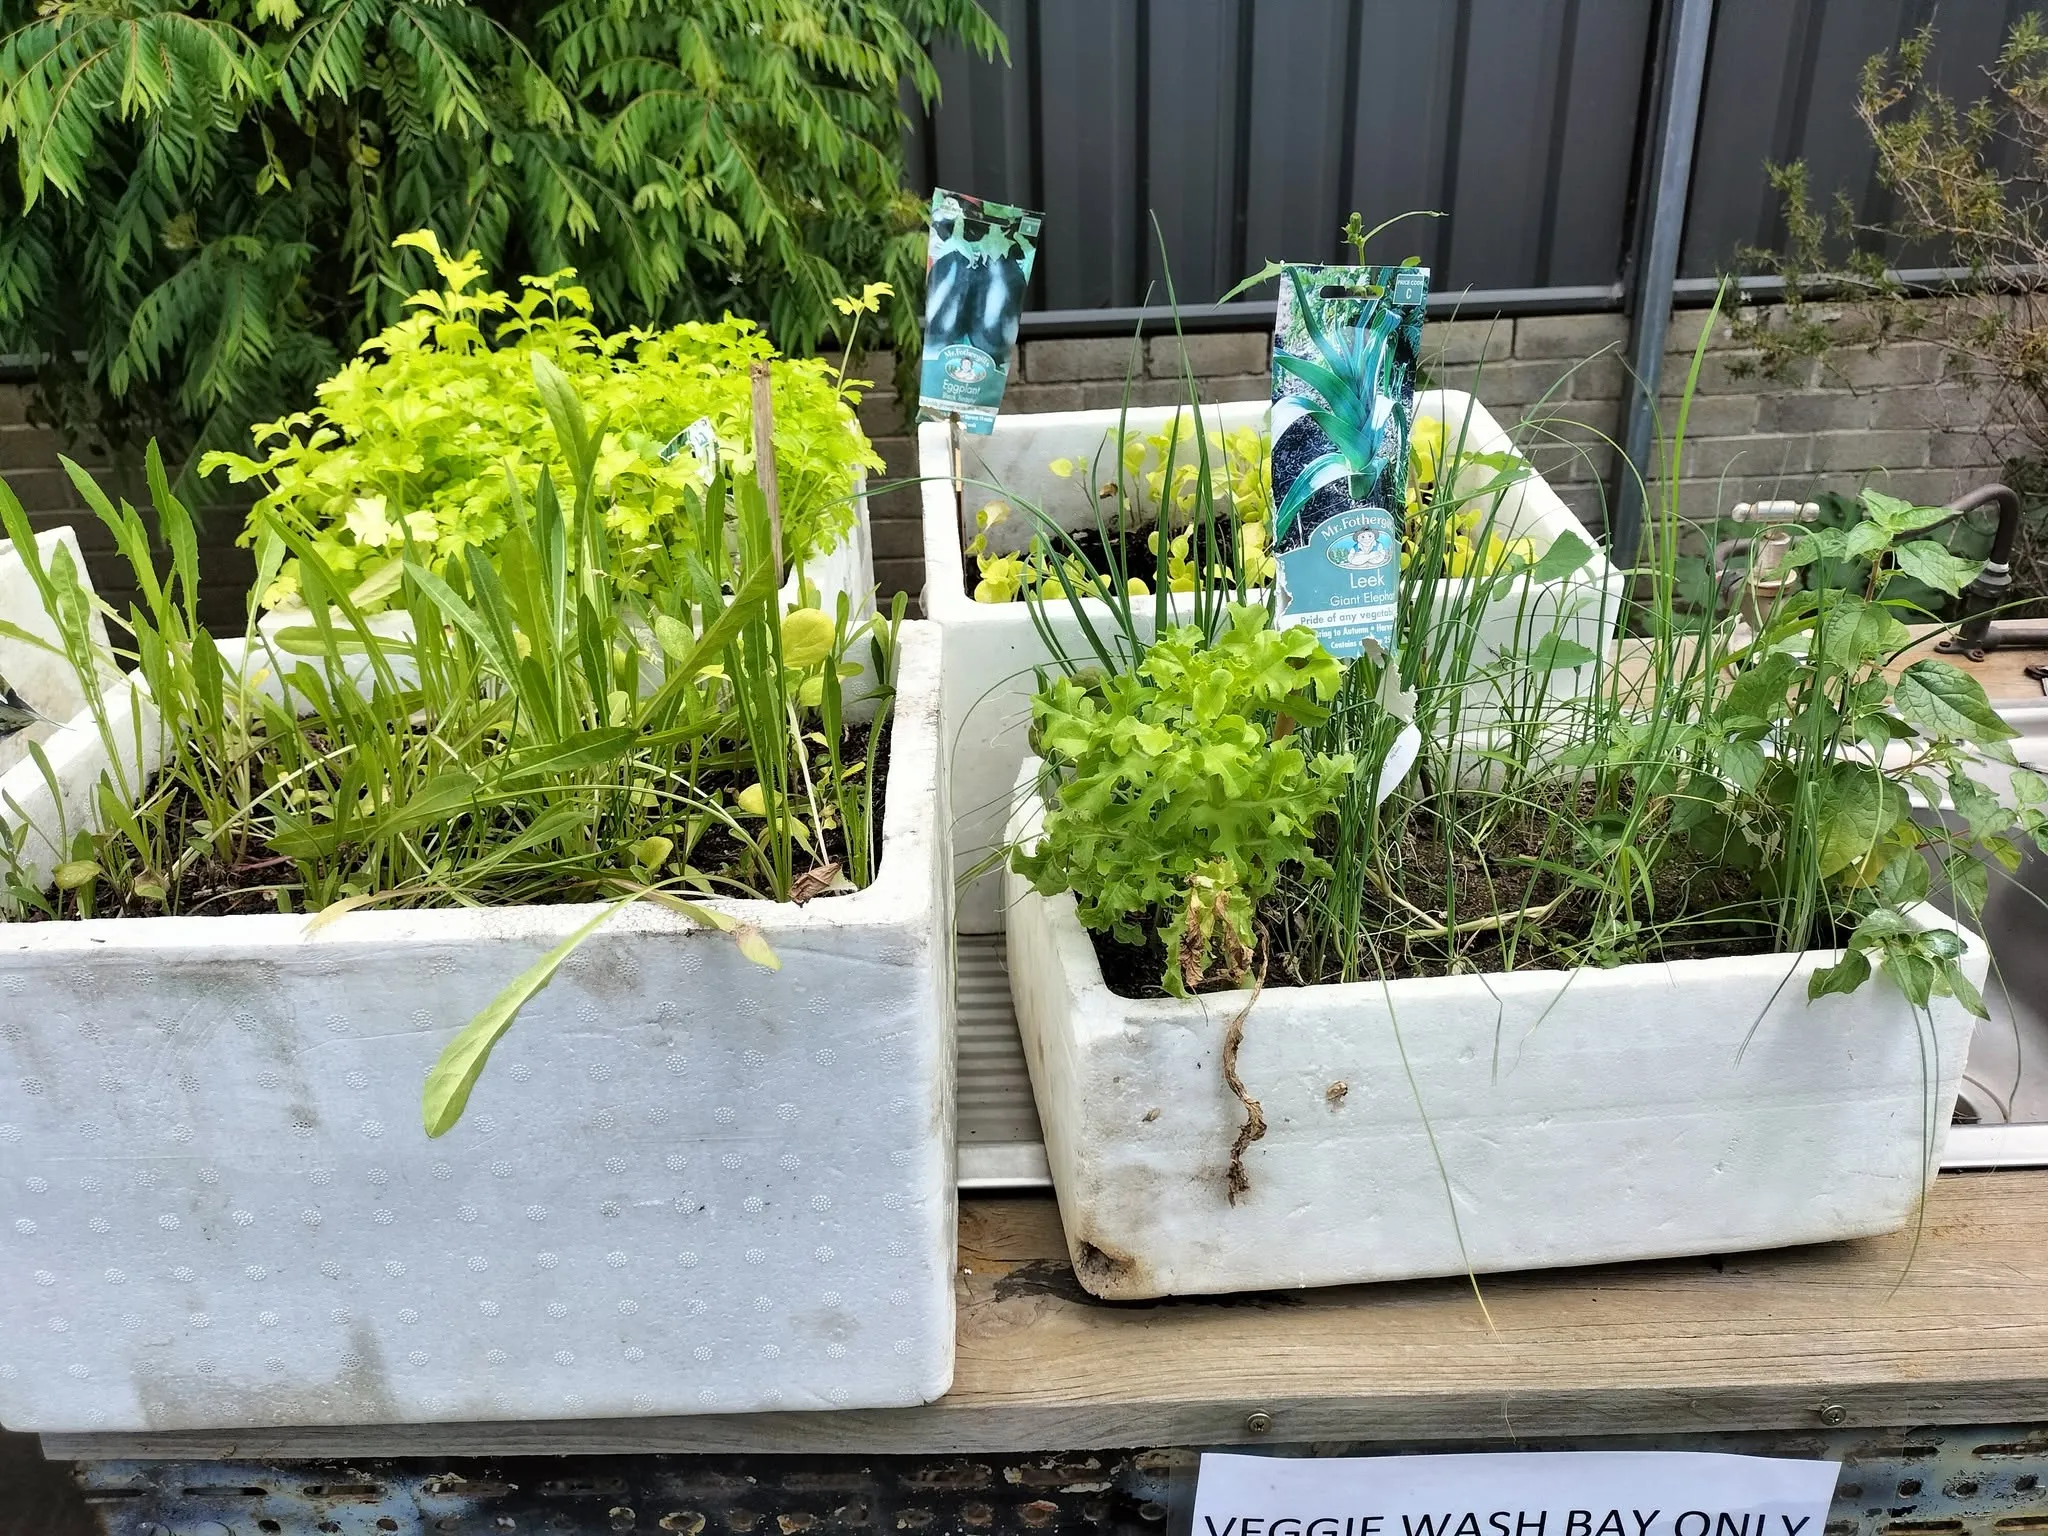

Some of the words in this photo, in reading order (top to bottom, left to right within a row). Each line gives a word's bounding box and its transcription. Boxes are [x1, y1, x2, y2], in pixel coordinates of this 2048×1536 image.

[1405, 287, 1412, 299] C
[942, 379, 981, 395] Eggplant
[1350, 569, 1385, 589] Leek
[1330, 594, 1360, 606] Giant
[1300, 614, 1324, 625] Pride
[1328, 612, 1337, 622] of
[1339, 613, 1357, 623] any
[1360, 608, 1393, 620] vegetab
[1334, 629, 1341, 637] to
[1343, 627, 1369, 636] Autumn
[1330, 640, 1357, 649] Contains
[1402, 1510, 1547, 1536] WASH
[1566, 1509, 1661, 1536] BAY
